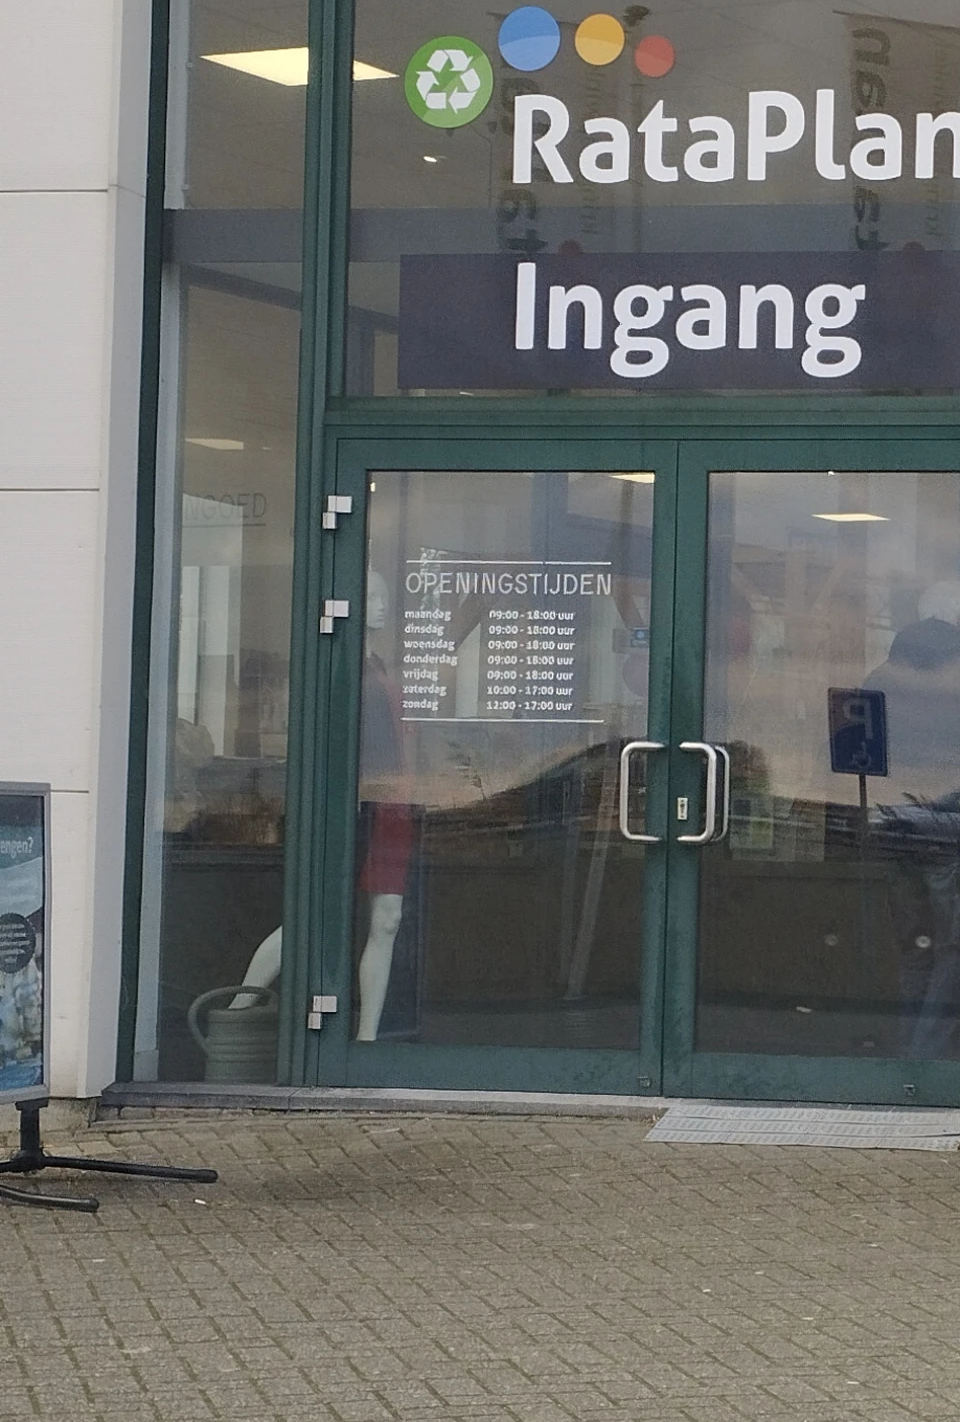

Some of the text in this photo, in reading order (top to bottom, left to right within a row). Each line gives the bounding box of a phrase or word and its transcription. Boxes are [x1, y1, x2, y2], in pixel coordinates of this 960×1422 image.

[514, 261, 867, 378] Ingang
[405, 572, 613, 596] OPENINGSTIJDEN
[404, 608, 452, 621] maandag
[489, 610, 519, 620] 09:00
[527, 610, 556, 620] 18:00
[558, 612, 575, 620] uur
[404, 623, 444, 636] dinsdag
[488, 625, 519, 635] 09:00
[526, 625, 556, 635] 18:00
[557, 627, 575, 635] uur
[404, 639, 456, 651] woensdag
[488, 640, 518, 650] 09:00
[526, 640, 555, 650] 18:00
[557, 642, 575, 650] uur
[403, 653, 458, 666] donderdag
[487, 655, 517, 665] 09:00
[526, 655, 555, 665] 18:00
[557, 657, 574, 665] uur
[402, 668, 438, 681] vrijdag
[487, 670, 517, 680] 09:00
[525, 670, 554, 680] 18:00
[556, 672, 574, 680] uur
[402, 684, 447, 696] zaterdag
[486, 685, 516, 695] 10:00
[525, 685, 554, 695] 17:00
[556, 687, 573, 695] uur
[402, 699, 439, 711] zondag
[486, 701, 516, 711] 12:00
[524, 701, 553, 711] 17:00
[555, 703, 573, 711] uur
